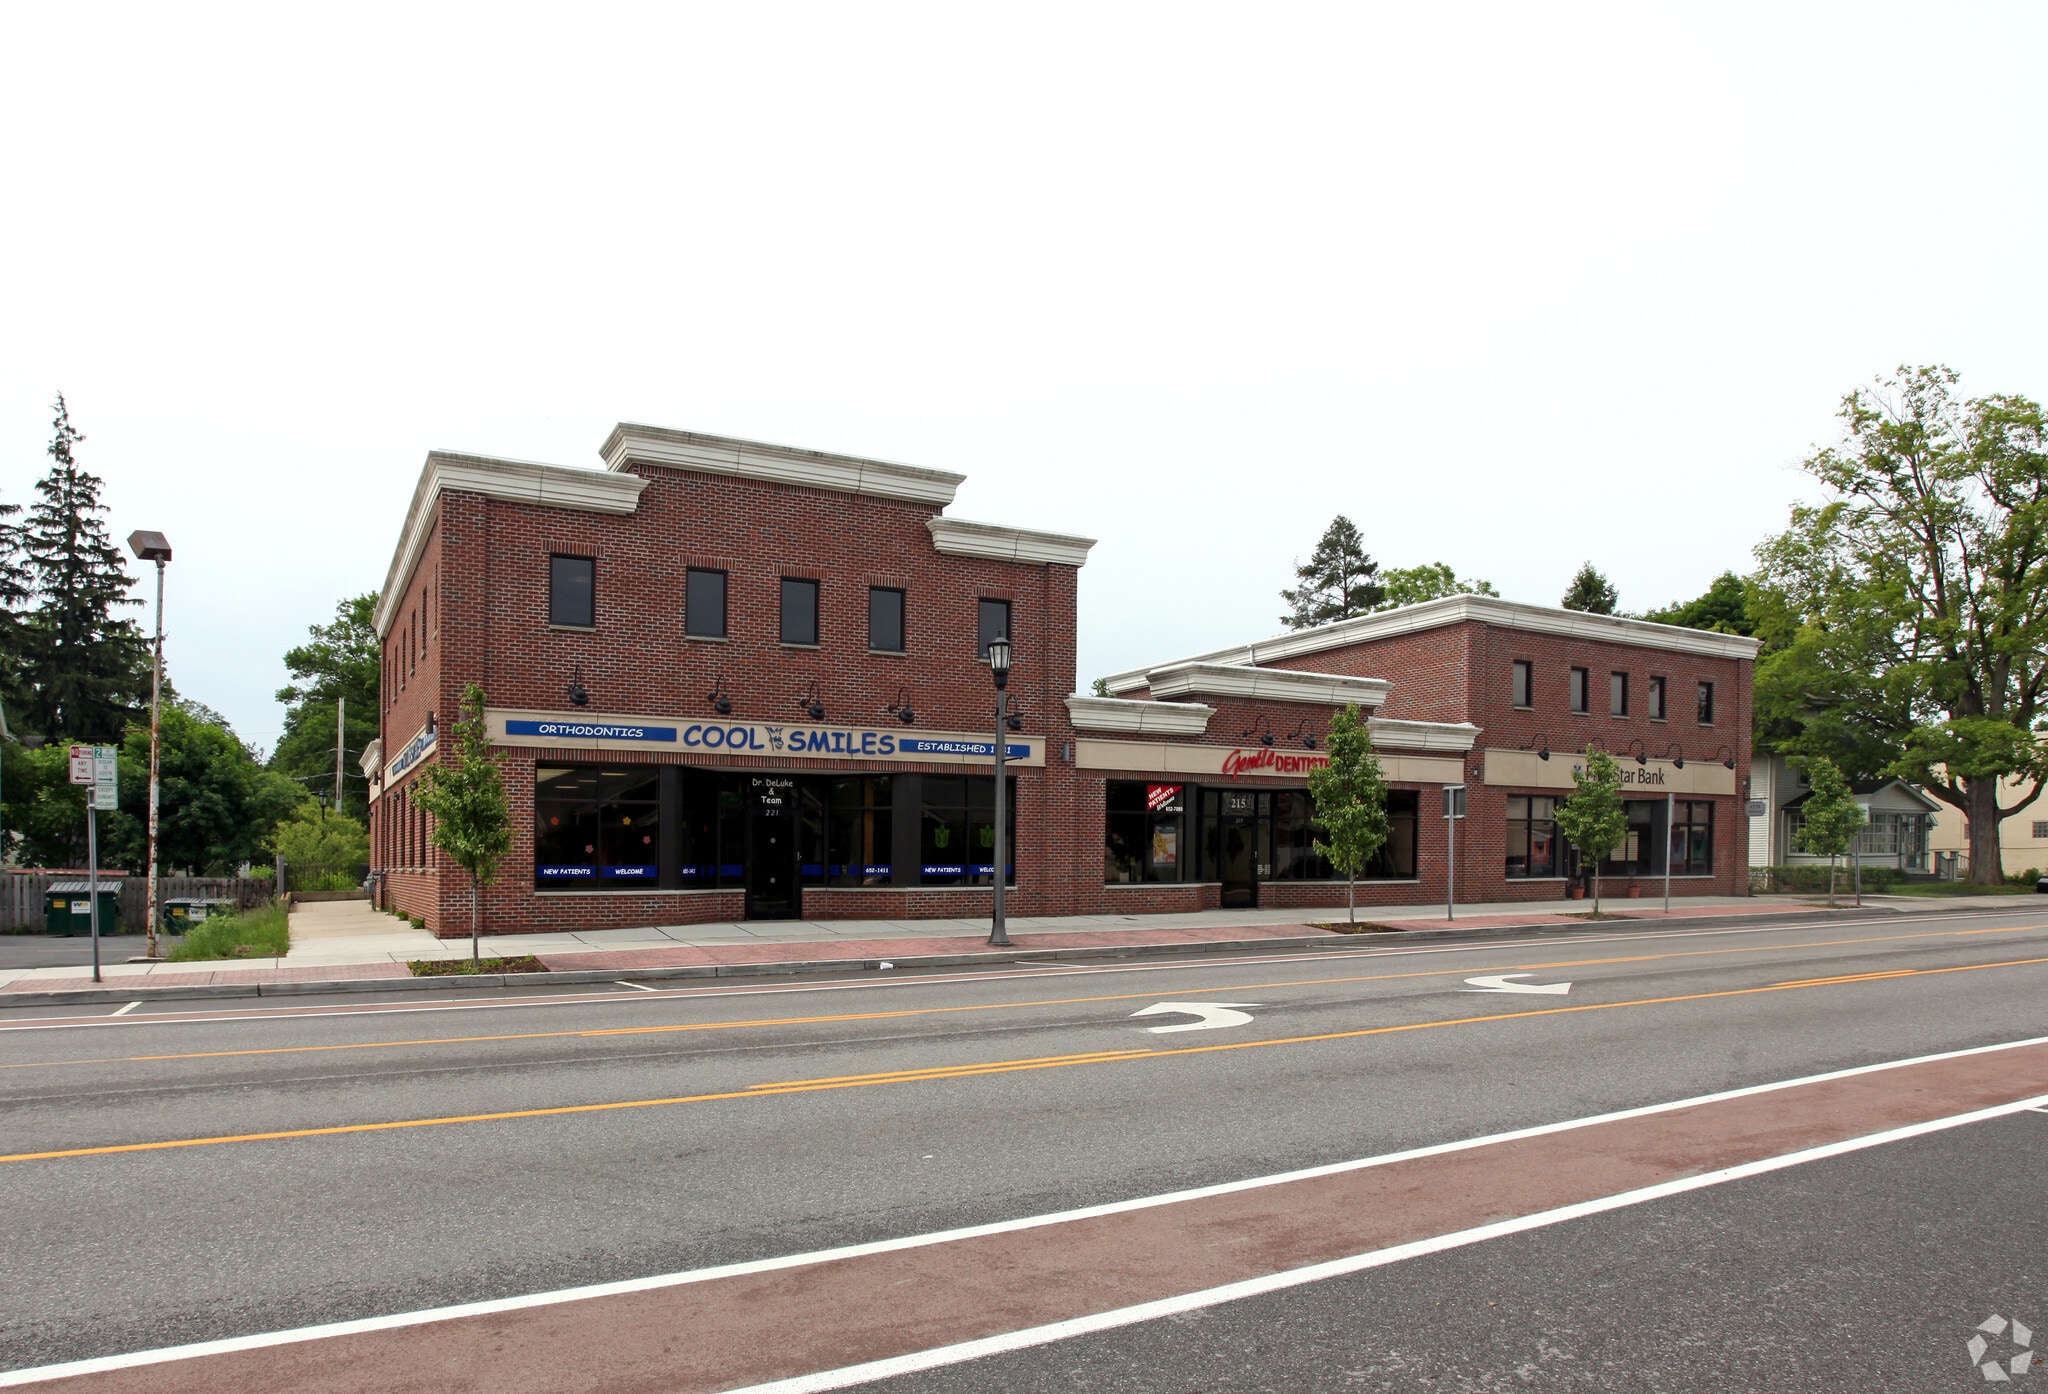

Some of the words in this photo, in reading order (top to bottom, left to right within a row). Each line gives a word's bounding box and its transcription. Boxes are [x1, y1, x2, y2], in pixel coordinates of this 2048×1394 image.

[538, 724, 644, 738] ORTHODONTICS
[683, 725, 765, 750] COOL
[787, 730, 896, 755] SMILES
[917, 742, 986, 753] ESTABLISHED
[1222, 748, 1275, 780] Gentle
[1275, 755, 1331, 772] DENTIST
[1637, 767, 1665, 785] Bank
[752, 778, 765, 786] Dr.
[765, 778, 794, 787] DeLuke
[768, 787, 775, 796] &
[1148, 787, 1162, 799] NEW
[760, 795, 783, 805] Team
[1148, 787, 1174, 808] PATIENTS
[1230, 798, 1246, 809] 215
[765, 809, 779, 817] 221
